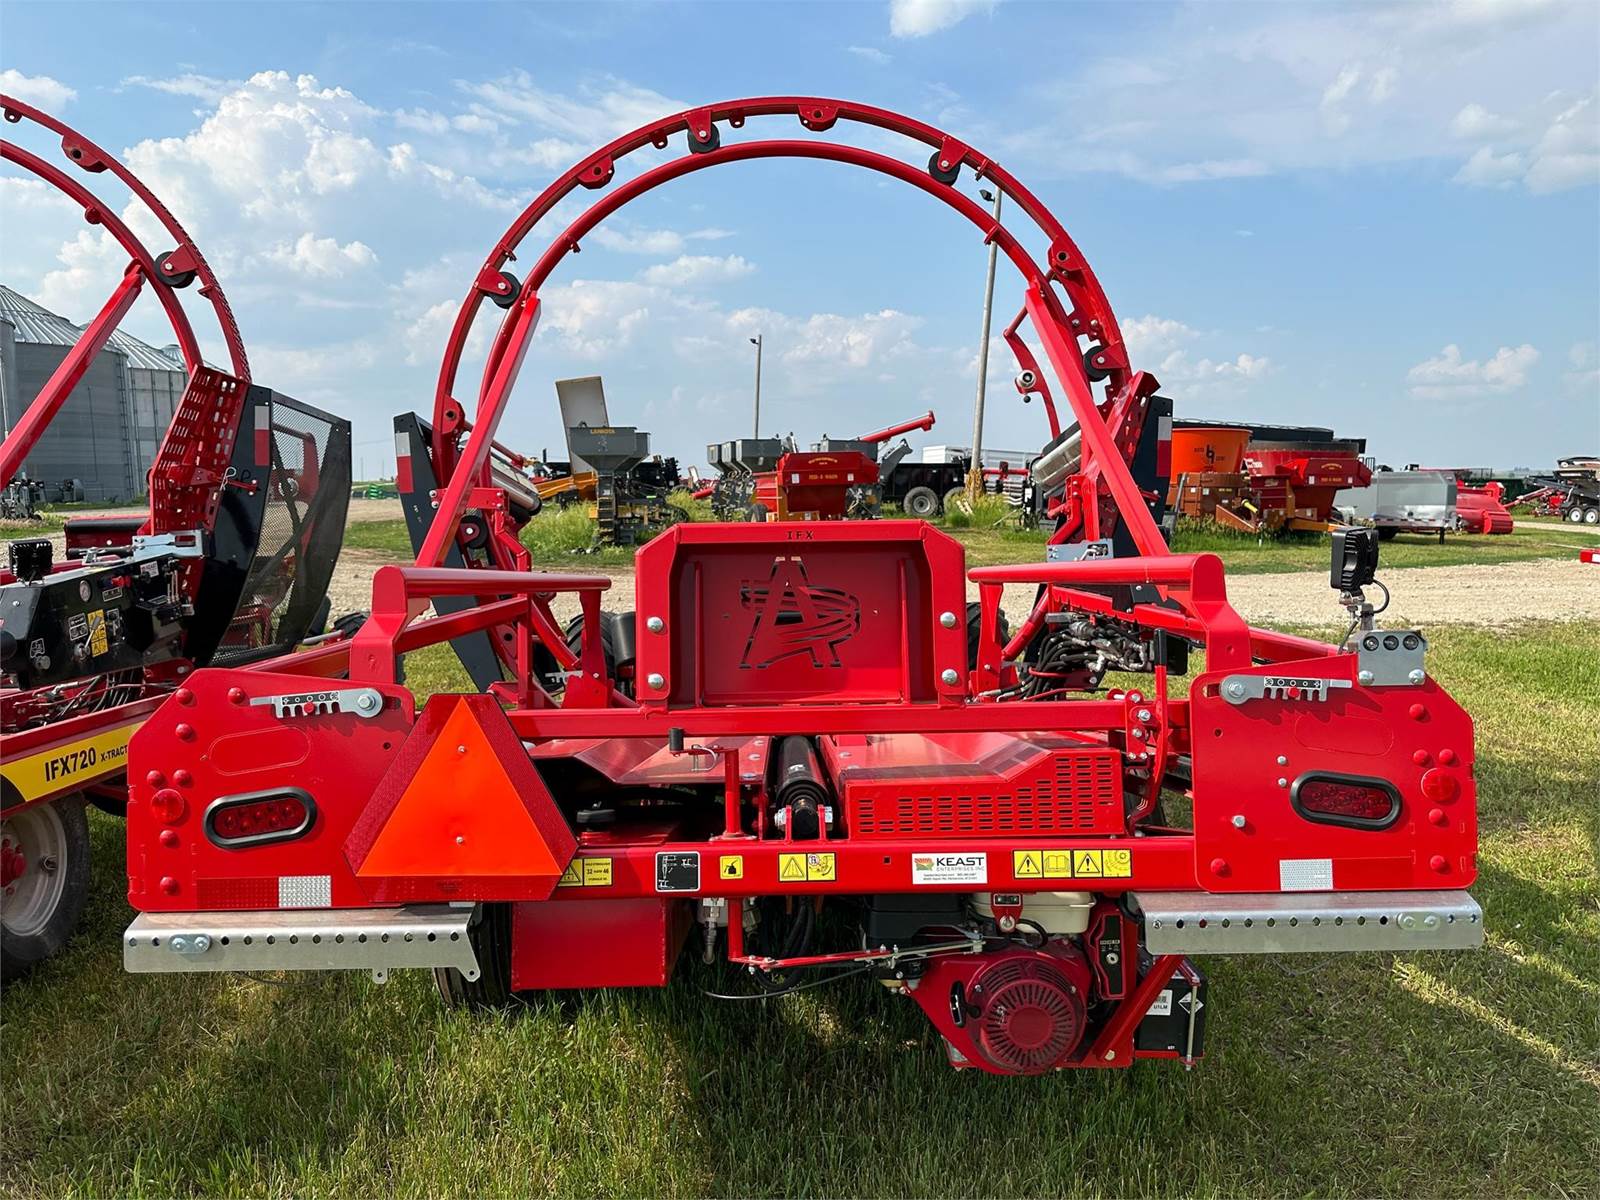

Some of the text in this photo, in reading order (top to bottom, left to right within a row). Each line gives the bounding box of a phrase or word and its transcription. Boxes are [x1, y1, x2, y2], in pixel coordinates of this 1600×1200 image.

[787, 530, 813, 540] IFX
[44, 747, 97, 782] IFX720
[936, 857, 984, 866] KEAST
